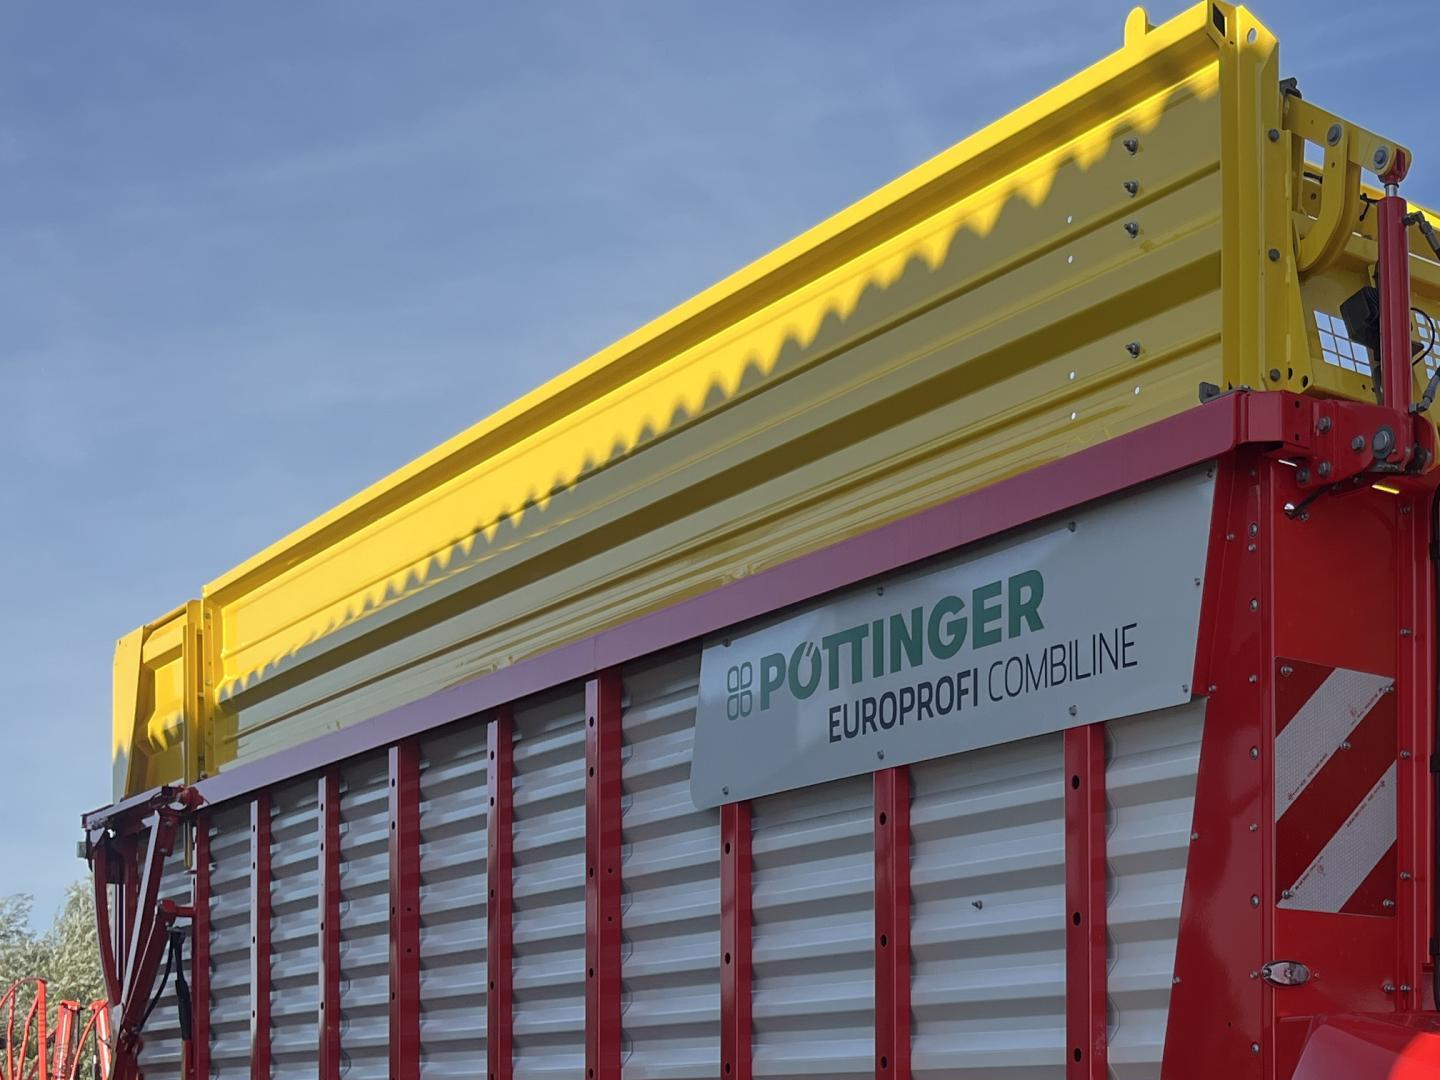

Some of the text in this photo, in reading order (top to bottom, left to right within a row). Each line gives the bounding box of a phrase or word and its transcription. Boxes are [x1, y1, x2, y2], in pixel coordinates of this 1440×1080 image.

[760, 569, 1045, 711] PÖTTINGER
[829, 622, 1138, 744] EUROPROFI COMBILINE
